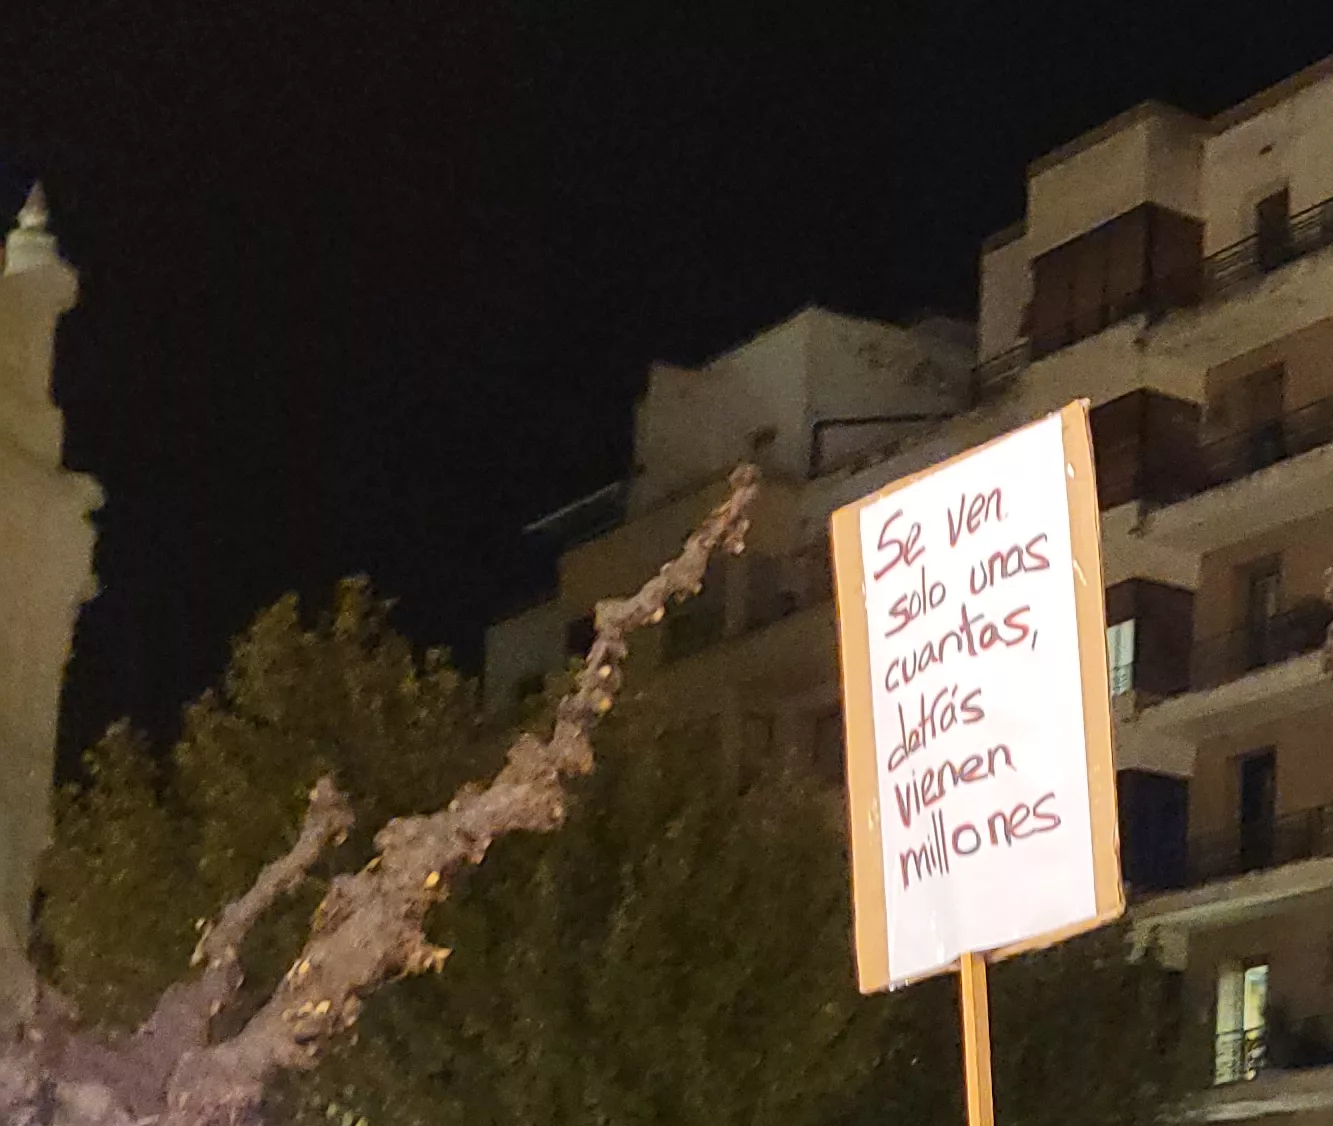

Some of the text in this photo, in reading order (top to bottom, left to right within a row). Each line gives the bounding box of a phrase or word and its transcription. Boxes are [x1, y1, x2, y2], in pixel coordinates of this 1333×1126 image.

[874, 508, 926, 580] Se
[886, 532, 1050, 636] solo unas
[886, 603, 1037, 691] cuantas,
[895, 744, 1016, 827] vienen
[900, 793, 1061, 888] millones
